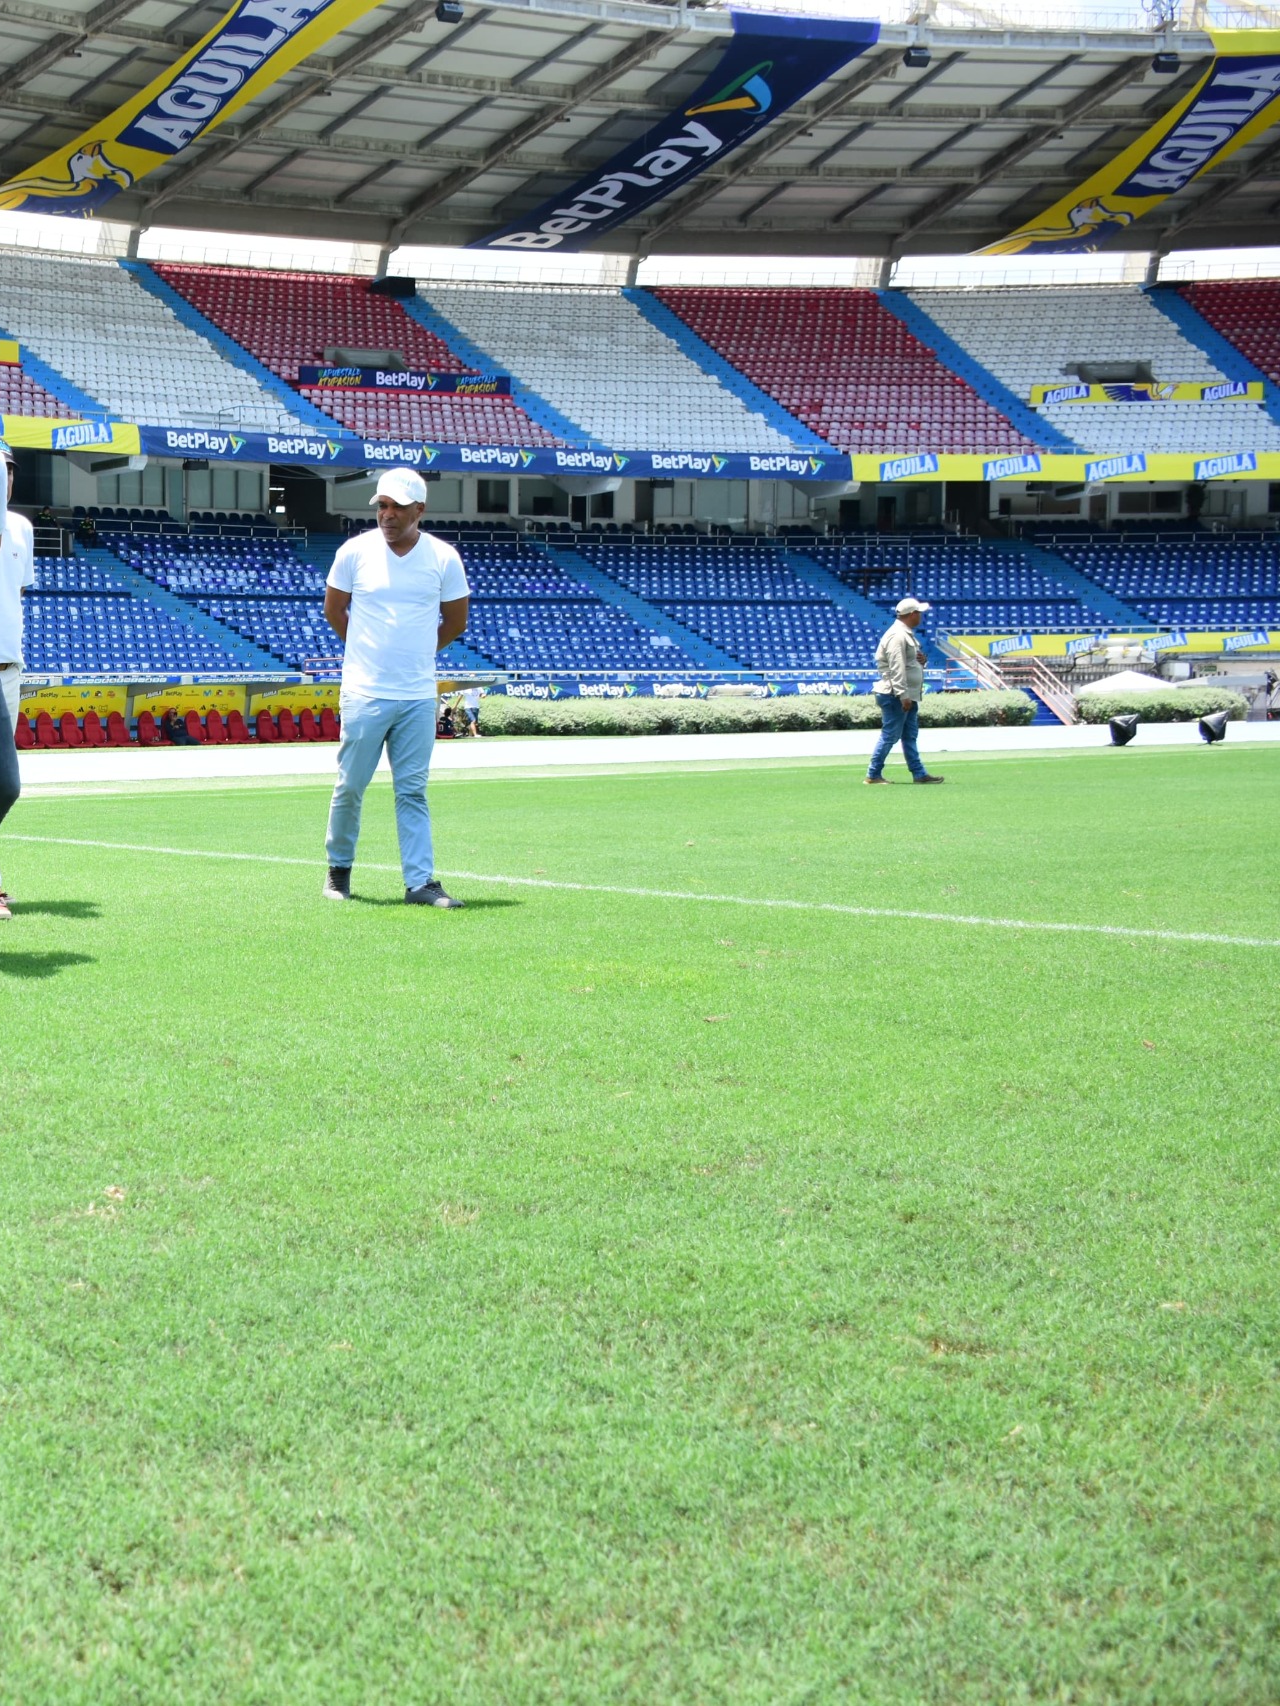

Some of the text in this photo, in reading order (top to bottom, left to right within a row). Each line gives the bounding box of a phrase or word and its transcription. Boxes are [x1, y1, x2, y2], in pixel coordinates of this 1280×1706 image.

[134, 0, 325, 149] AGUILA
[1127, 64, 1280, 189] AGUILA
[488, 121, 722, 249] BetPlay
[376, 371, 425, 390] BetPlay
[1045, 385, 1087, 404] AGUILA
[1202, 382, 1245, 400] AGUILA
[55, 423, 109, 449] AGUILA
[166, 431, 228, 453] BetPlay
[267, 437, 326, 459] BetPlay
[363, 444, 422, 465] BetPlay
[460, 448, 519, 468] BetPlay
[555, 451, 613, 471] BetPlay
[651, 454, 711, 473] BetPlay
[749, 456, 808, 475] BetPlay
[882, 455, 935, 481] AGUILA
[986, 455, 1038, 481] AGUILA
[1088, 454, 1143, 481] AGUILA
[1197, 453, 1252, 480] AGUILA
[990, 636, 1031, 656] AGUILA
[1147, 634, 1185, 653] AGUILA
[1225, 632, 1267, 651] AGUILA
[506, 683, 549, 698] BetPlay
[579, 683, 625, 697] BetPlay
[797, 682, 844, 695] BetPlay
